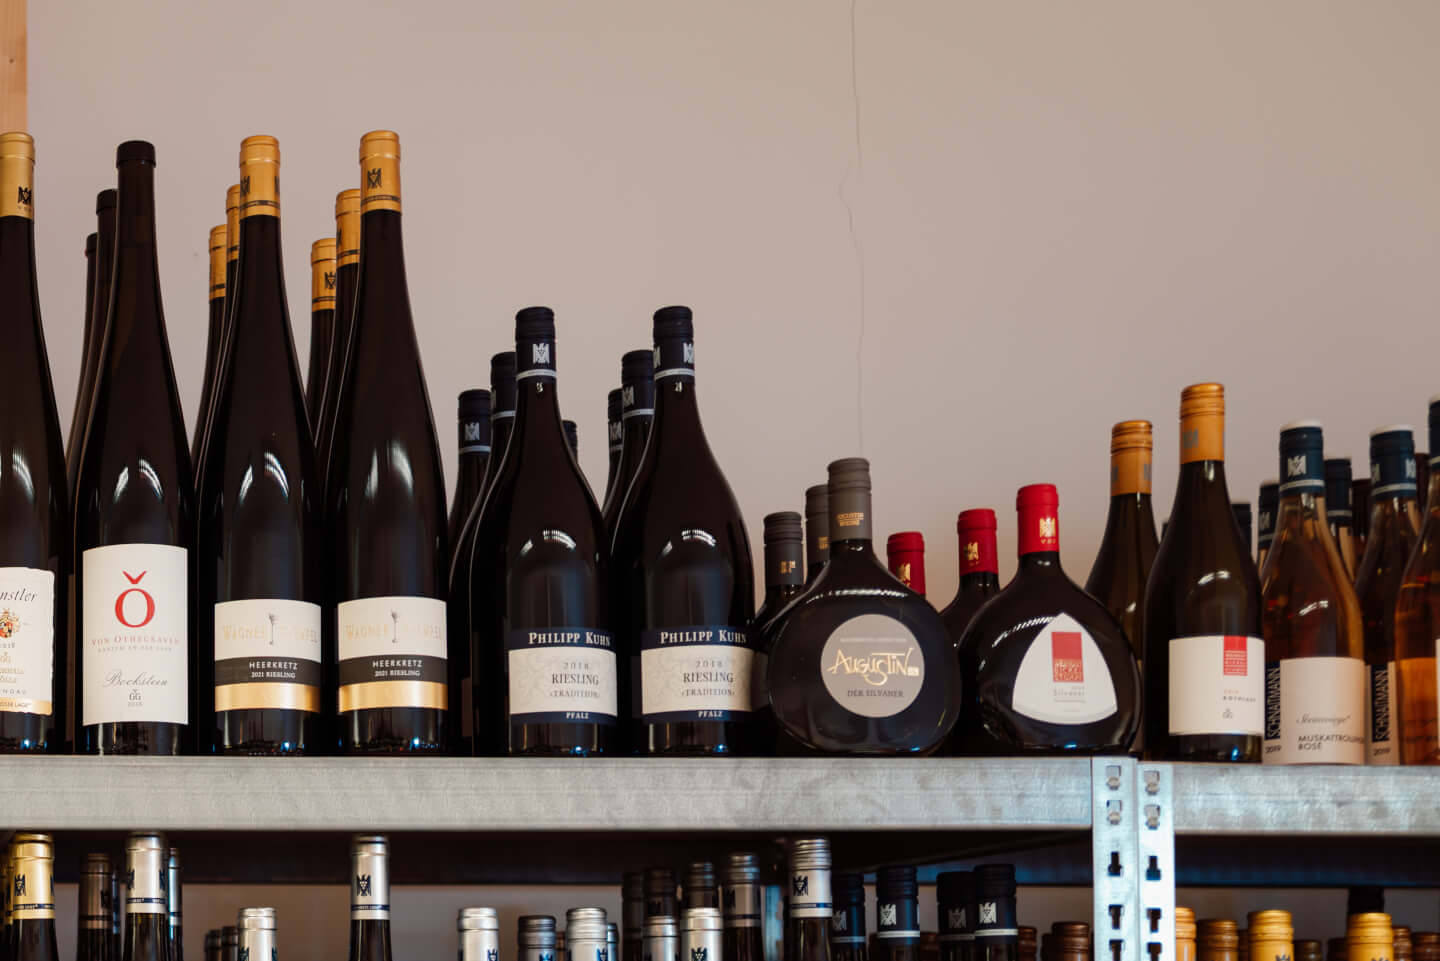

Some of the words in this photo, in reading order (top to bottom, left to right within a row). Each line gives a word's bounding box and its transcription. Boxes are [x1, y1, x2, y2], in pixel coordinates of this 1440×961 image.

[114, 635, 180, 645] OTHEGRAVEN
[529, 632, 580, 644] PHILIPP
[585, 632, 610, 646] KUHN
[661, 631, 712, 644] PHILIPP
[720, 630, 746, 643] KUHN
[373, 660, 423, 668] HEERKRETZ
[552, 675, 599, 686] RIESLING
[683, 673, 734, 683] RIESLING
